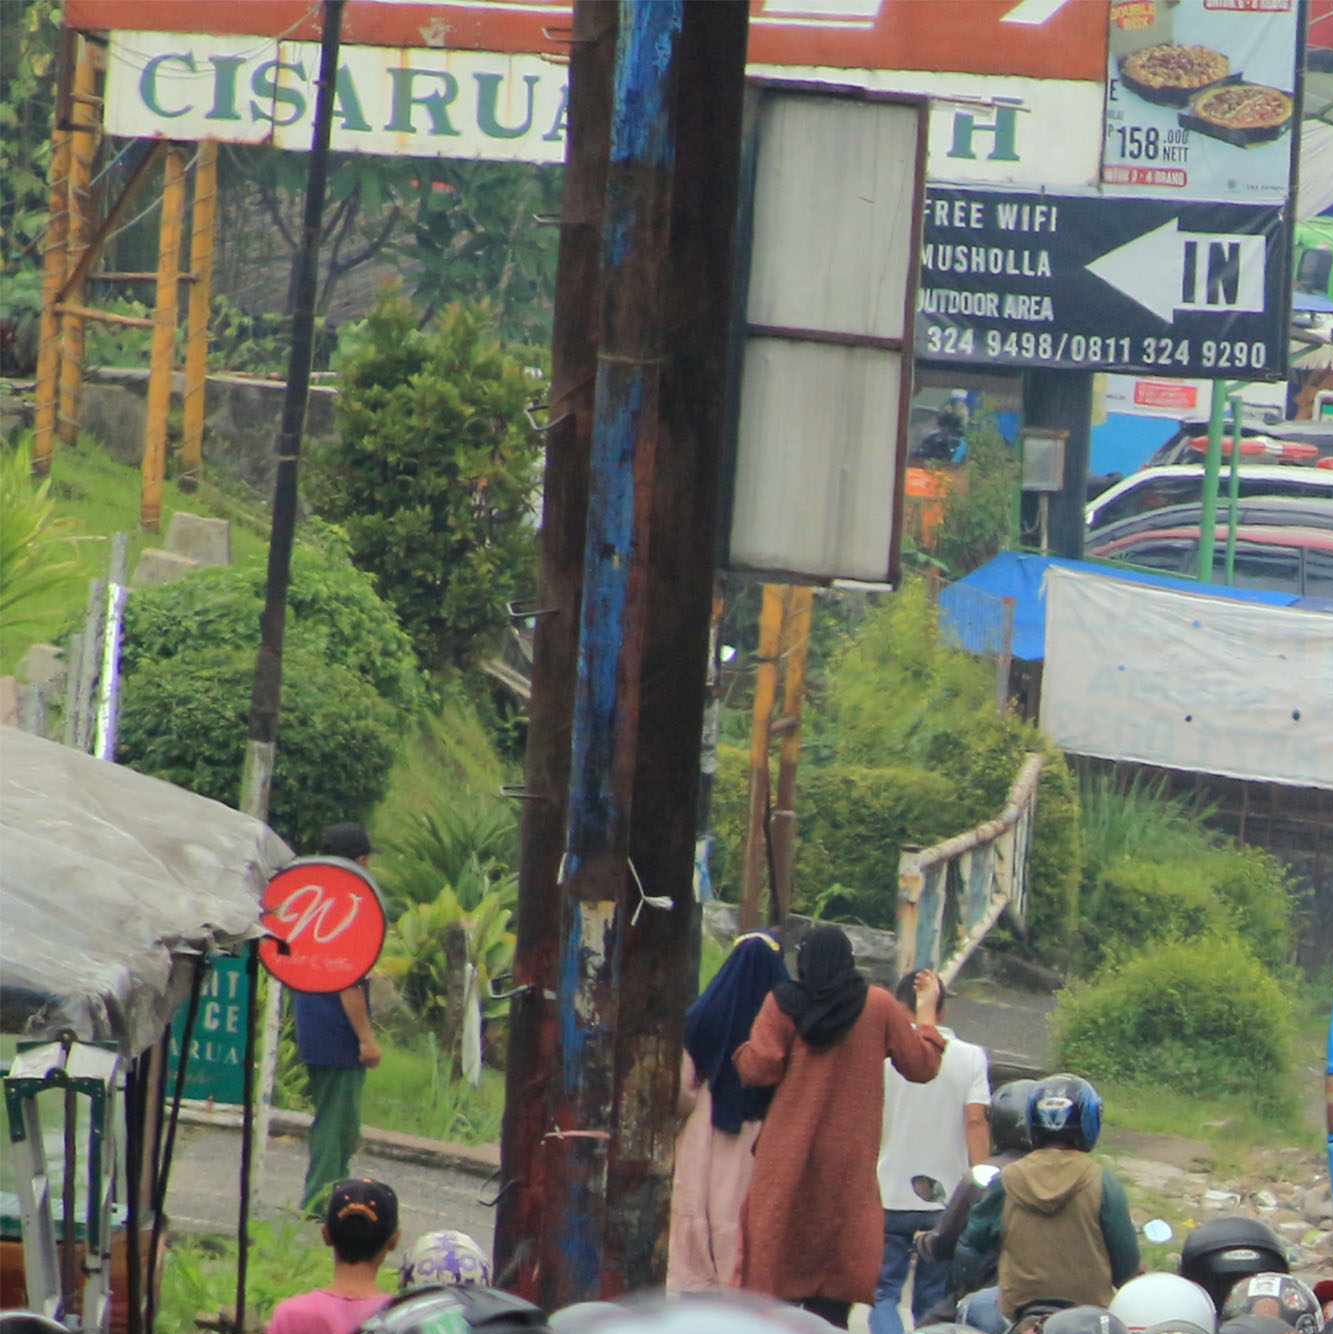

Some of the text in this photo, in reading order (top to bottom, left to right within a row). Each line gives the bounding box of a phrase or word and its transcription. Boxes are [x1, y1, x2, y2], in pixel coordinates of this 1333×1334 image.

[1116, 125, 1159, 161] 158
[1162, 146, 1189, 163] NETT
[924, 199, 1058, 232] FREE WIFI
[921, 243, 1052, 278] MUSHOLLA
[1182, 240, 1241, 306] IN
[1002, 293, 1055, 322] AREA
[926, 325, 1267, 369] 324 9498/0811 324 9290
